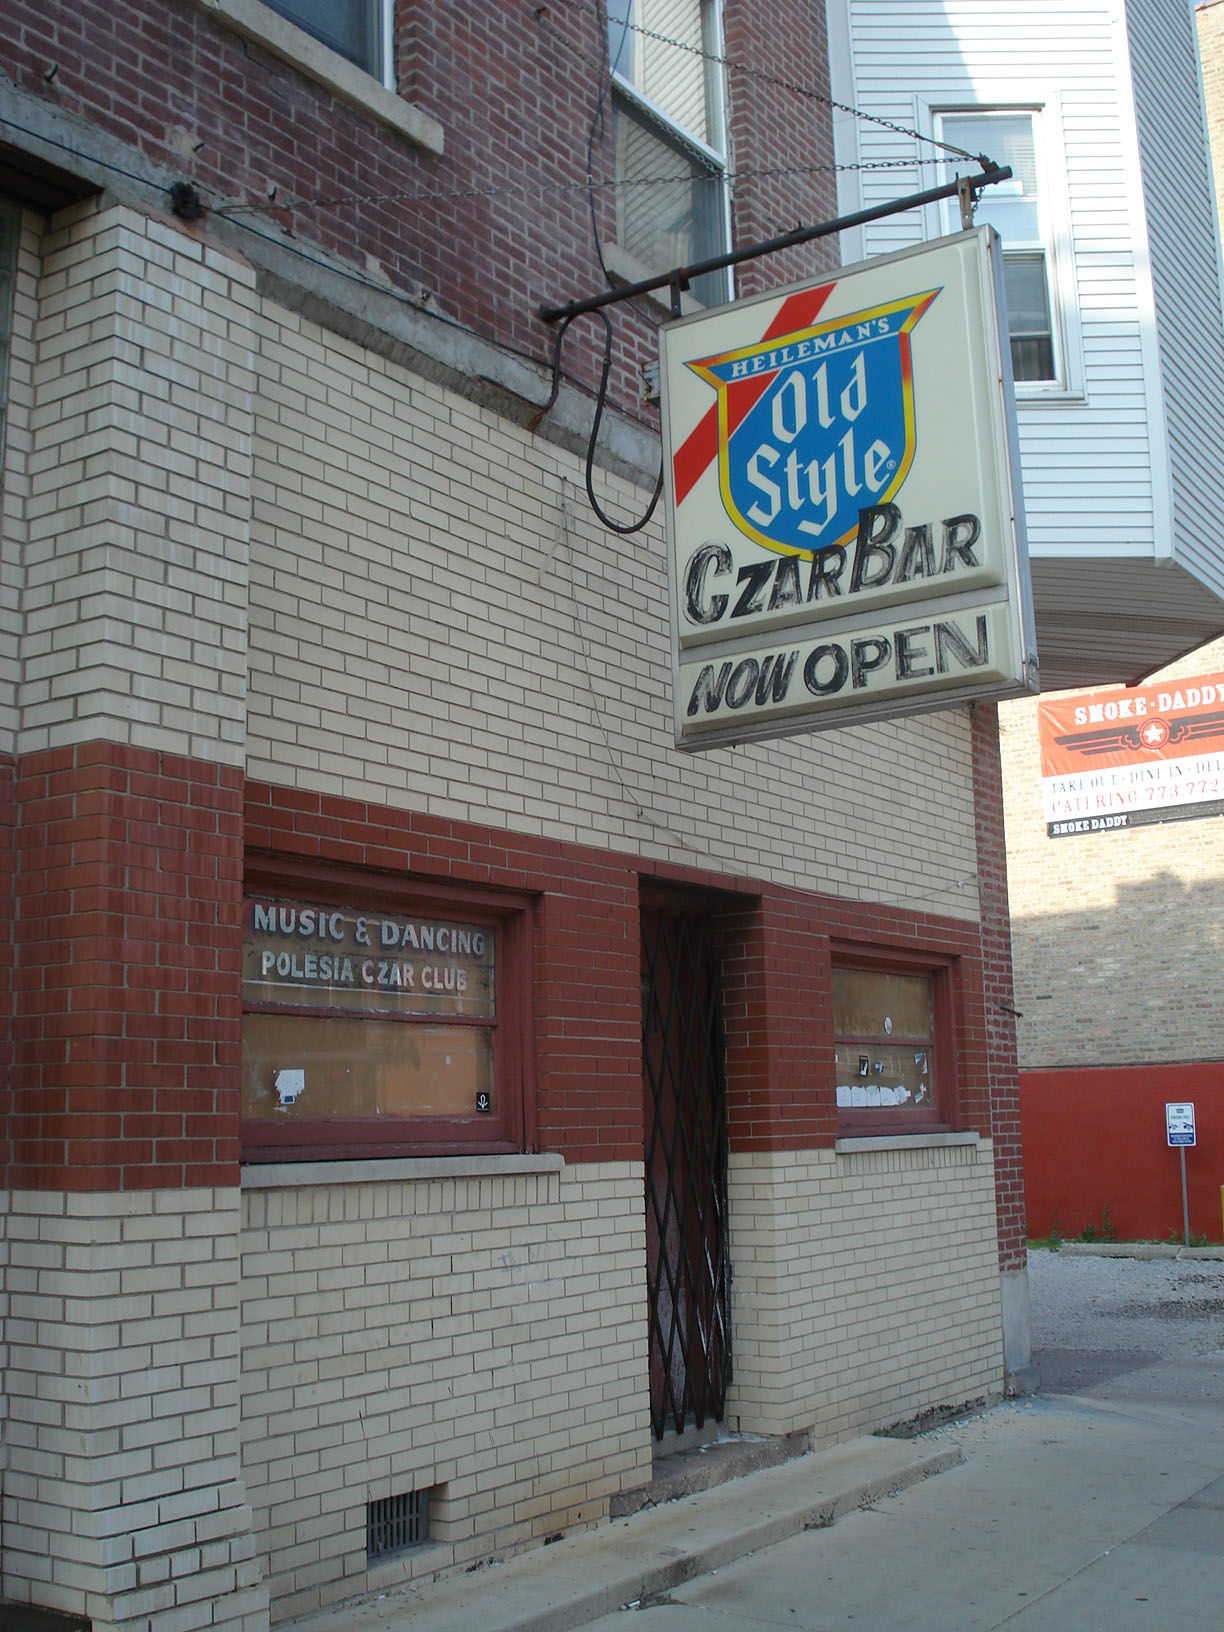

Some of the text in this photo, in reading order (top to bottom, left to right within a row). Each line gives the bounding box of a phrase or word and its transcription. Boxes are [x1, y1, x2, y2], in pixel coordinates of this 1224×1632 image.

[731, 317, 890, 378] HEILEMAN'S
[772, 350, 868, 444] Old
[746, 426, 892, 536] Style
[687, 615, 989, 717] NOW OPEN
[1053, 815, 1128, 835] SMOKE DADDY
[254, 904, 485, 955] MUSIC & DANCING
[261, 951, 468, 991] POLESIA CZAR CLUB
